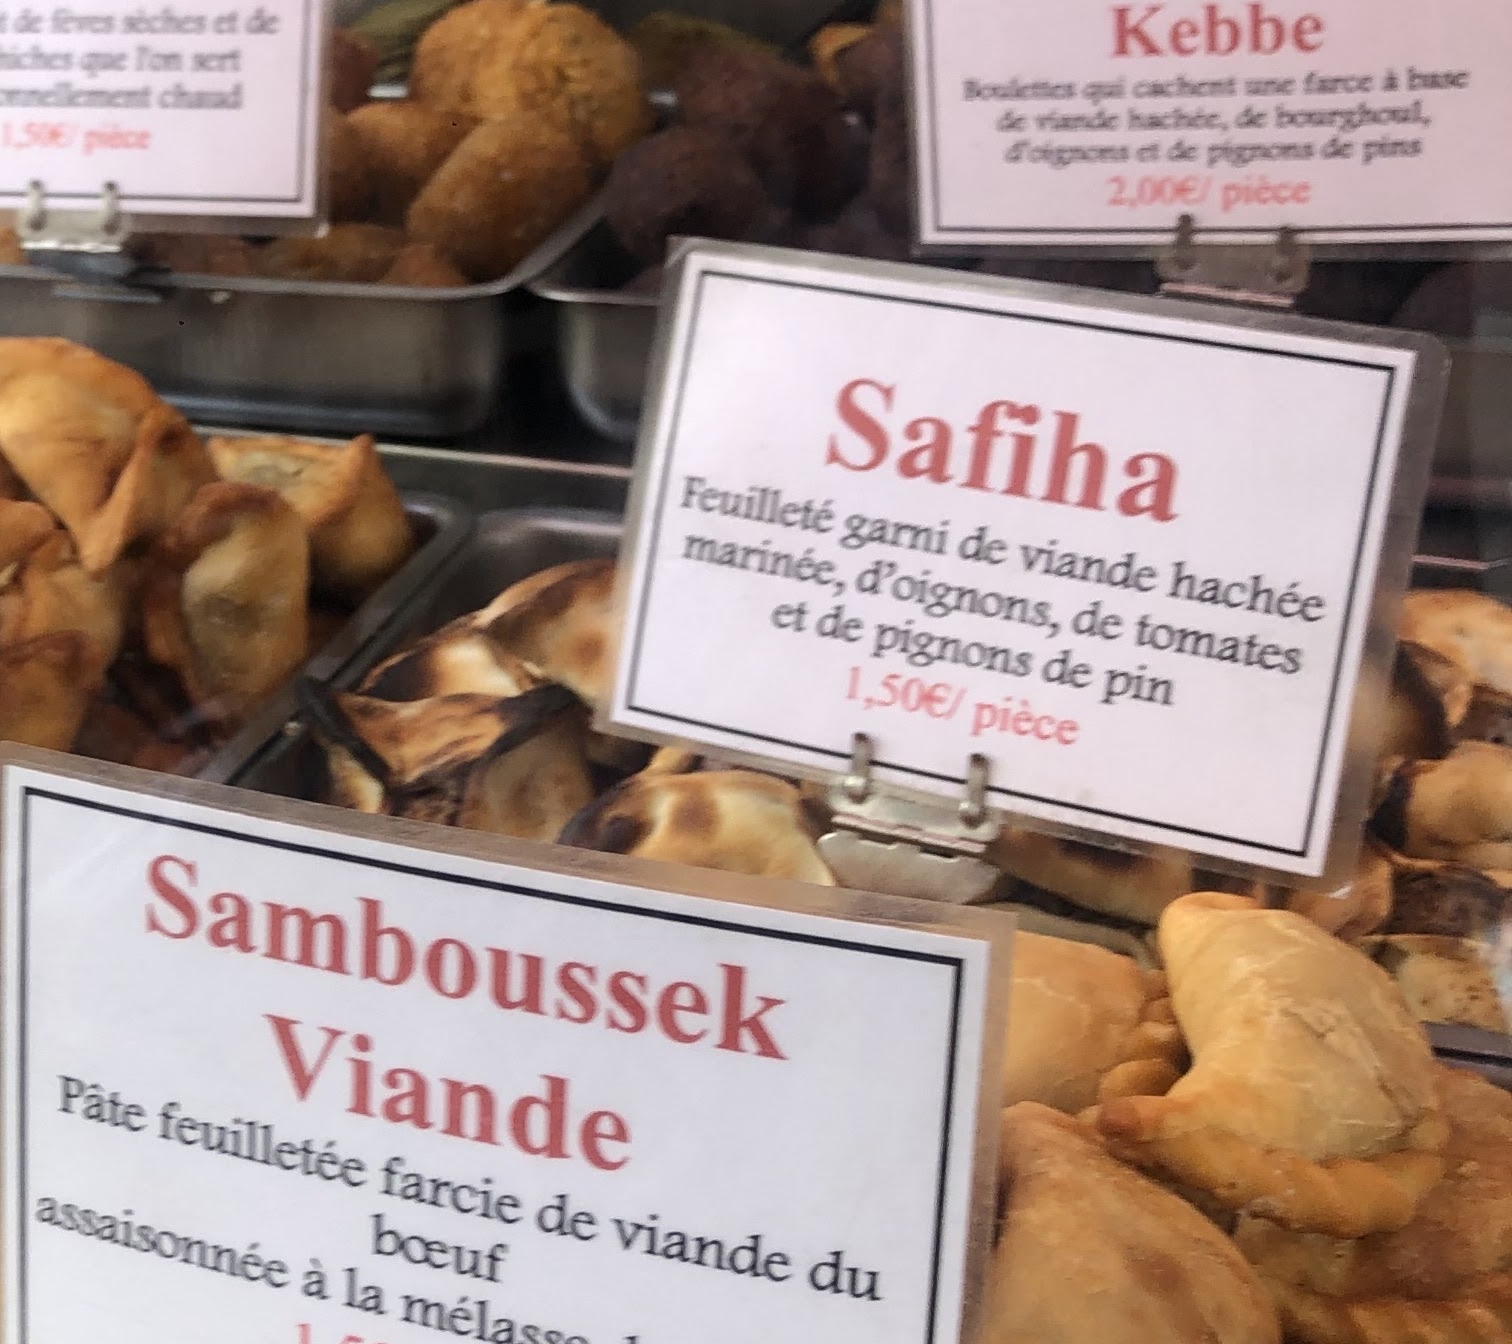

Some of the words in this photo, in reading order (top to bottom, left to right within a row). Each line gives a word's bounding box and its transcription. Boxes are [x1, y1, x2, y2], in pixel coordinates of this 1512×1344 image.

[14, 8, 42, 33] de
[213, 11, 238, 34] et
[245, 7, 280, 34] de
[1110, 2, 1324, 58] Kebbe
[81, 52, 128, 78] que
[191, 49, 241, 72] sert
[159, 82, 243, 109] chaud
[962, 78, 1076, 101] Boulettes
[1082, 75, 1126, 105] qui
[1133, 75, 1235, 99] cachent
[1245, 78, 1295, 96] une
[1303, 70, 1373, 94] farce
[1407, 66, 1470, 91] base
[83, 123, 151, 155] pièce
[996, 109, 1028, 132] de
[1035, 109, 1119, 131] viande
[1235, 106, 1267, 128] de
[1136, 143, 1159, 163] et
[1167, 138, 1196, 161] de
[1207, 140, 1313, 168] pignons
[1320, 135, 1353, 159] de
[1361, 135, 1422, 166] pins
[1221, 175, 1311, 213] pièce
[825, 377, 1181, 523] Safiha
[680, 475, 835, 535] Feuilleté
[840, 512, 950, 553] garni
[959, 528, 1006, 566] de
[1020, 538, 1159, 595] viande
[1169, 561, 1327, 624] hachée
[683, 528, 846, 595] marinée,
[856, 565, 1061, 641] d'oignons,
[1073, 603, 1124, 641] de
[1135, 609, 1303, 678] tomates
[772, 598, 807, 633] et
[816, 606, 864, 644] de
[874, 621, 1035, 681] pignons
[1042, 651, 1093, 689] de
[1103, 664, 1176, 709] pin
[844, 664, 965, 721] 1,50€/
[970, 693, 1079, 747] pièce
[145, 853, 790, 1063] Samboussek
[264, 1014, 634, 1172] Viande
[57, 1073, 149, 1134] Pâte
[157, 1099, 368, 1189] feuilletée
[380, 1156, 522, 1225] farcie
[534, 1191, 599, 1243] de
[613, 1209, 792, 1282] viande
[807, 1248, 884, 1303] du
[36, 1191, 291, 1289] assaisonnée
[301, 1258, 329, 1300] à
[344, 1266, 384, 1316] la
[372, 1213, 510, 1284] bœuf
